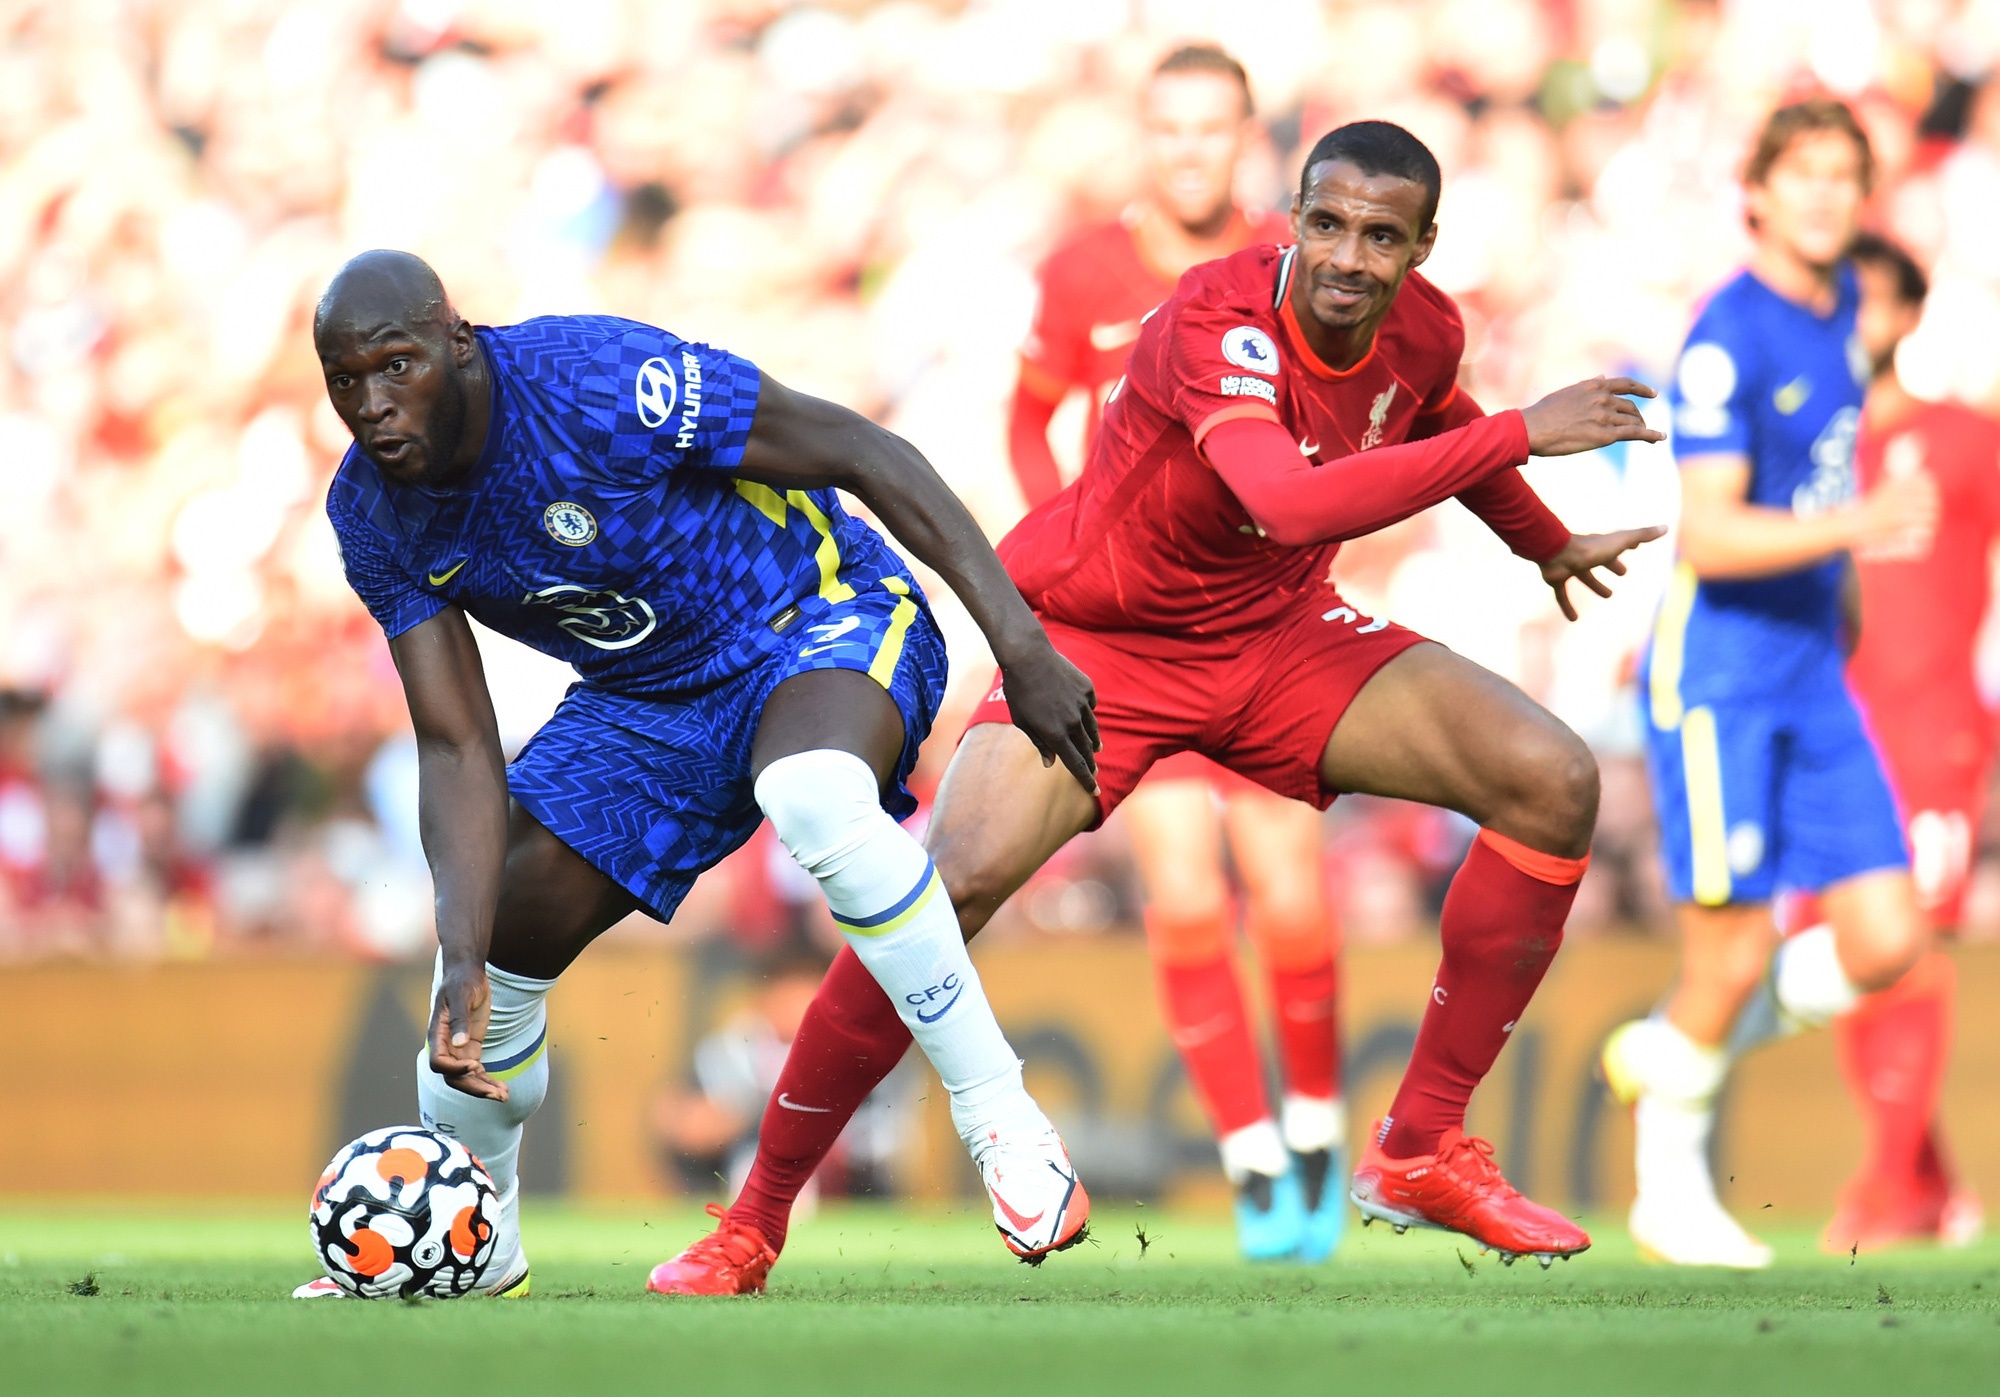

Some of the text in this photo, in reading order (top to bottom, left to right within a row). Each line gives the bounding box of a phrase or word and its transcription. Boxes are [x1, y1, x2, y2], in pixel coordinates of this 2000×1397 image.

[675, 350, 702, 449] HYUNDAI
[905, 972, 959, 1005] CFC
[423, 1111, 456, 1133] FC
